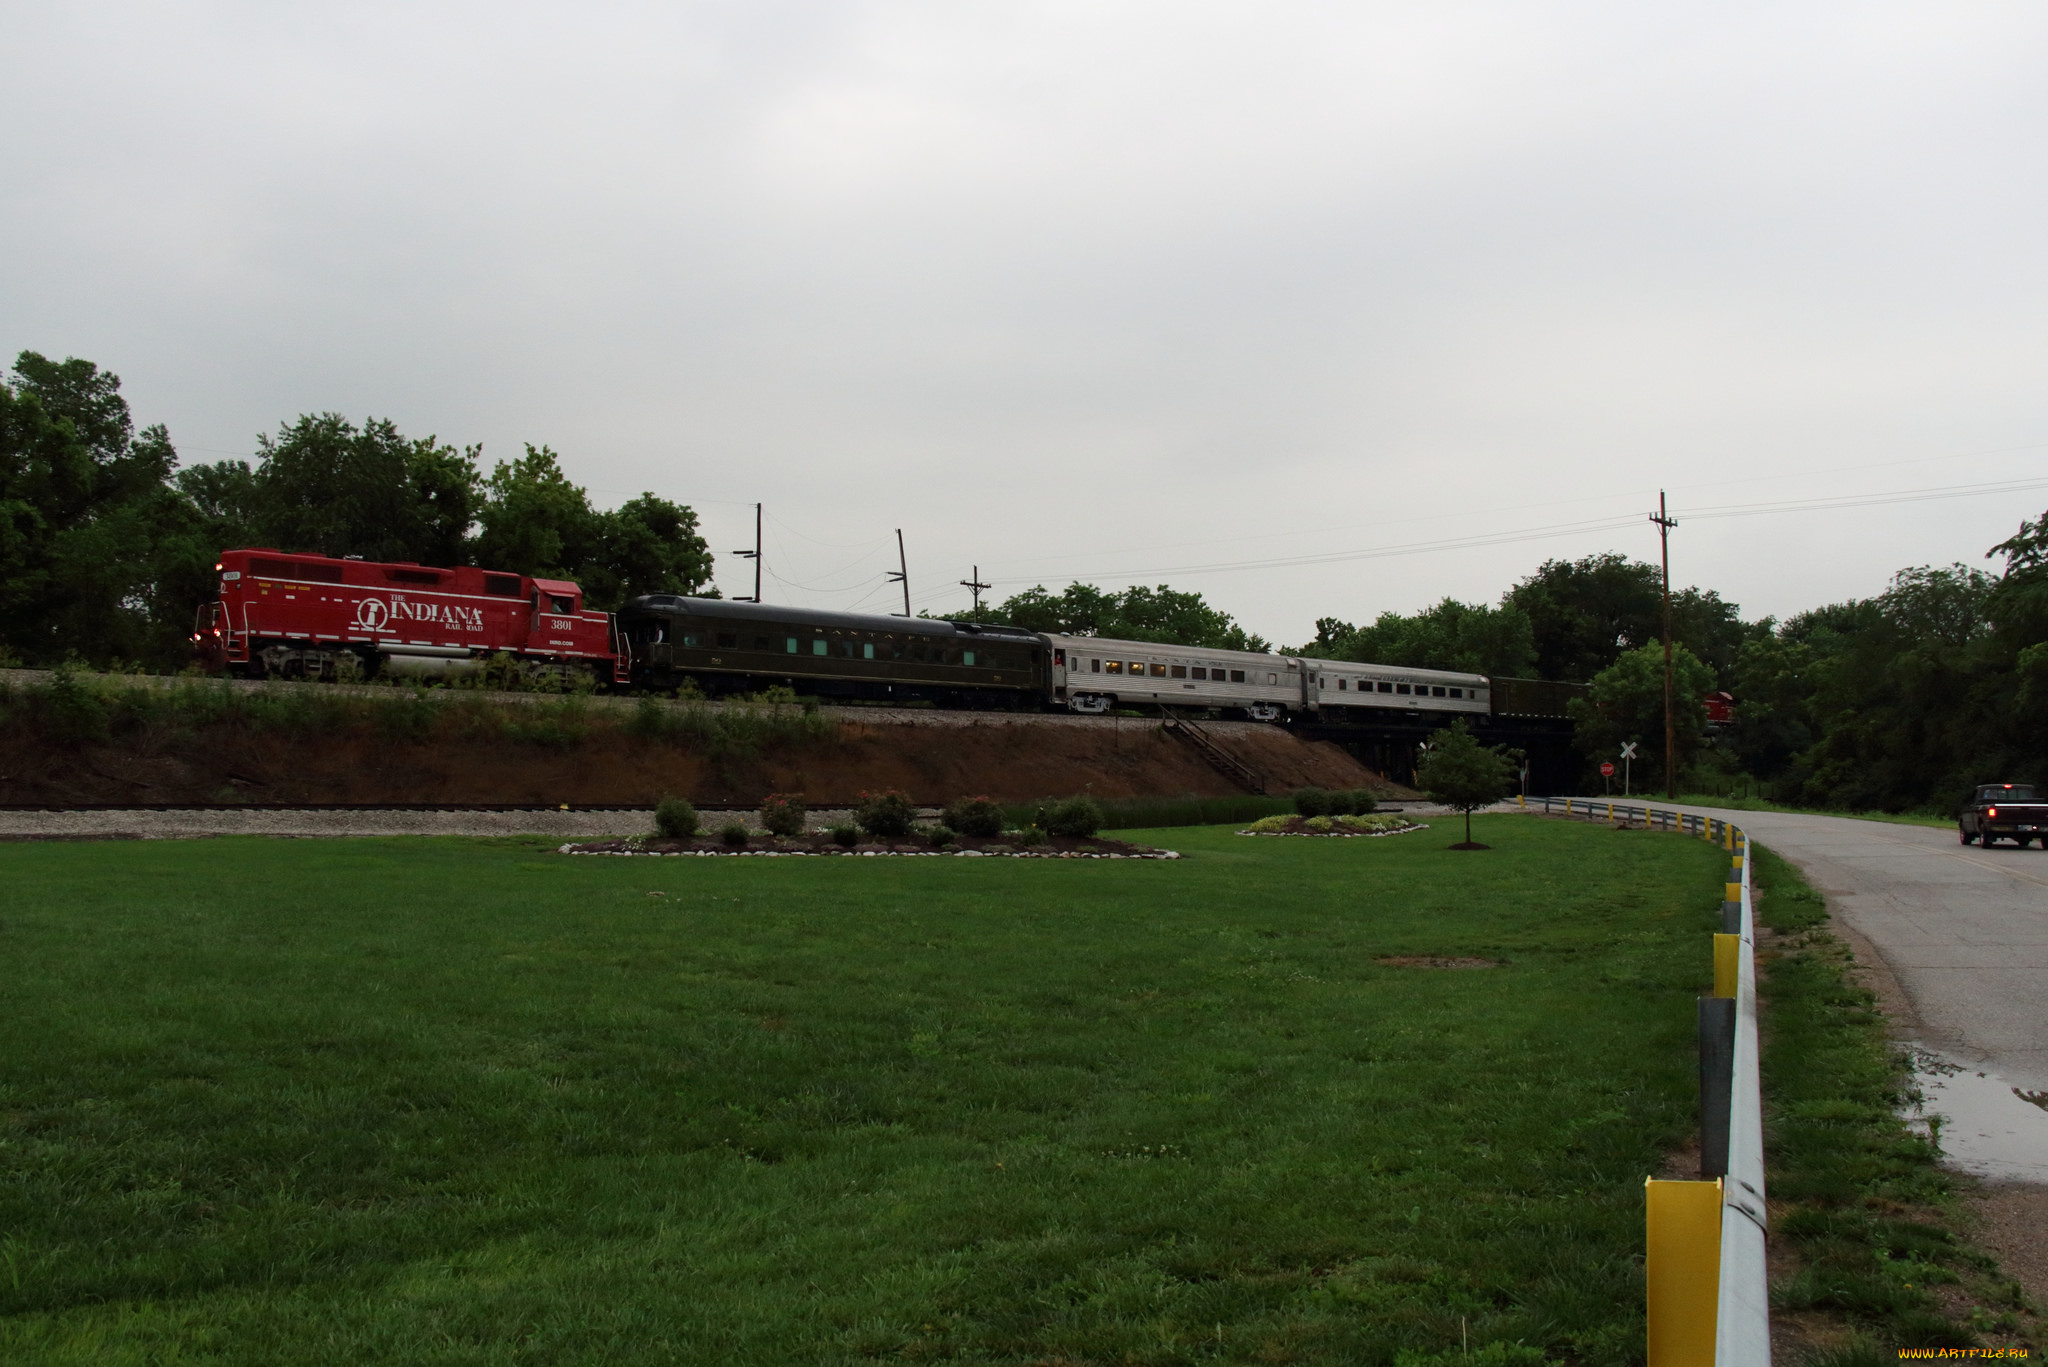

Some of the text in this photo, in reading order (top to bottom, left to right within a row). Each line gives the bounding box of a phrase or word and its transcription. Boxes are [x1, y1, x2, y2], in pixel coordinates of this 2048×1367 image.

[390, 594, 406, 602] THE
[390, 601, 483, 625] INDIANA
[445, 623, 463, 632] RAIL
[551, 619, 572, 631] 3801
